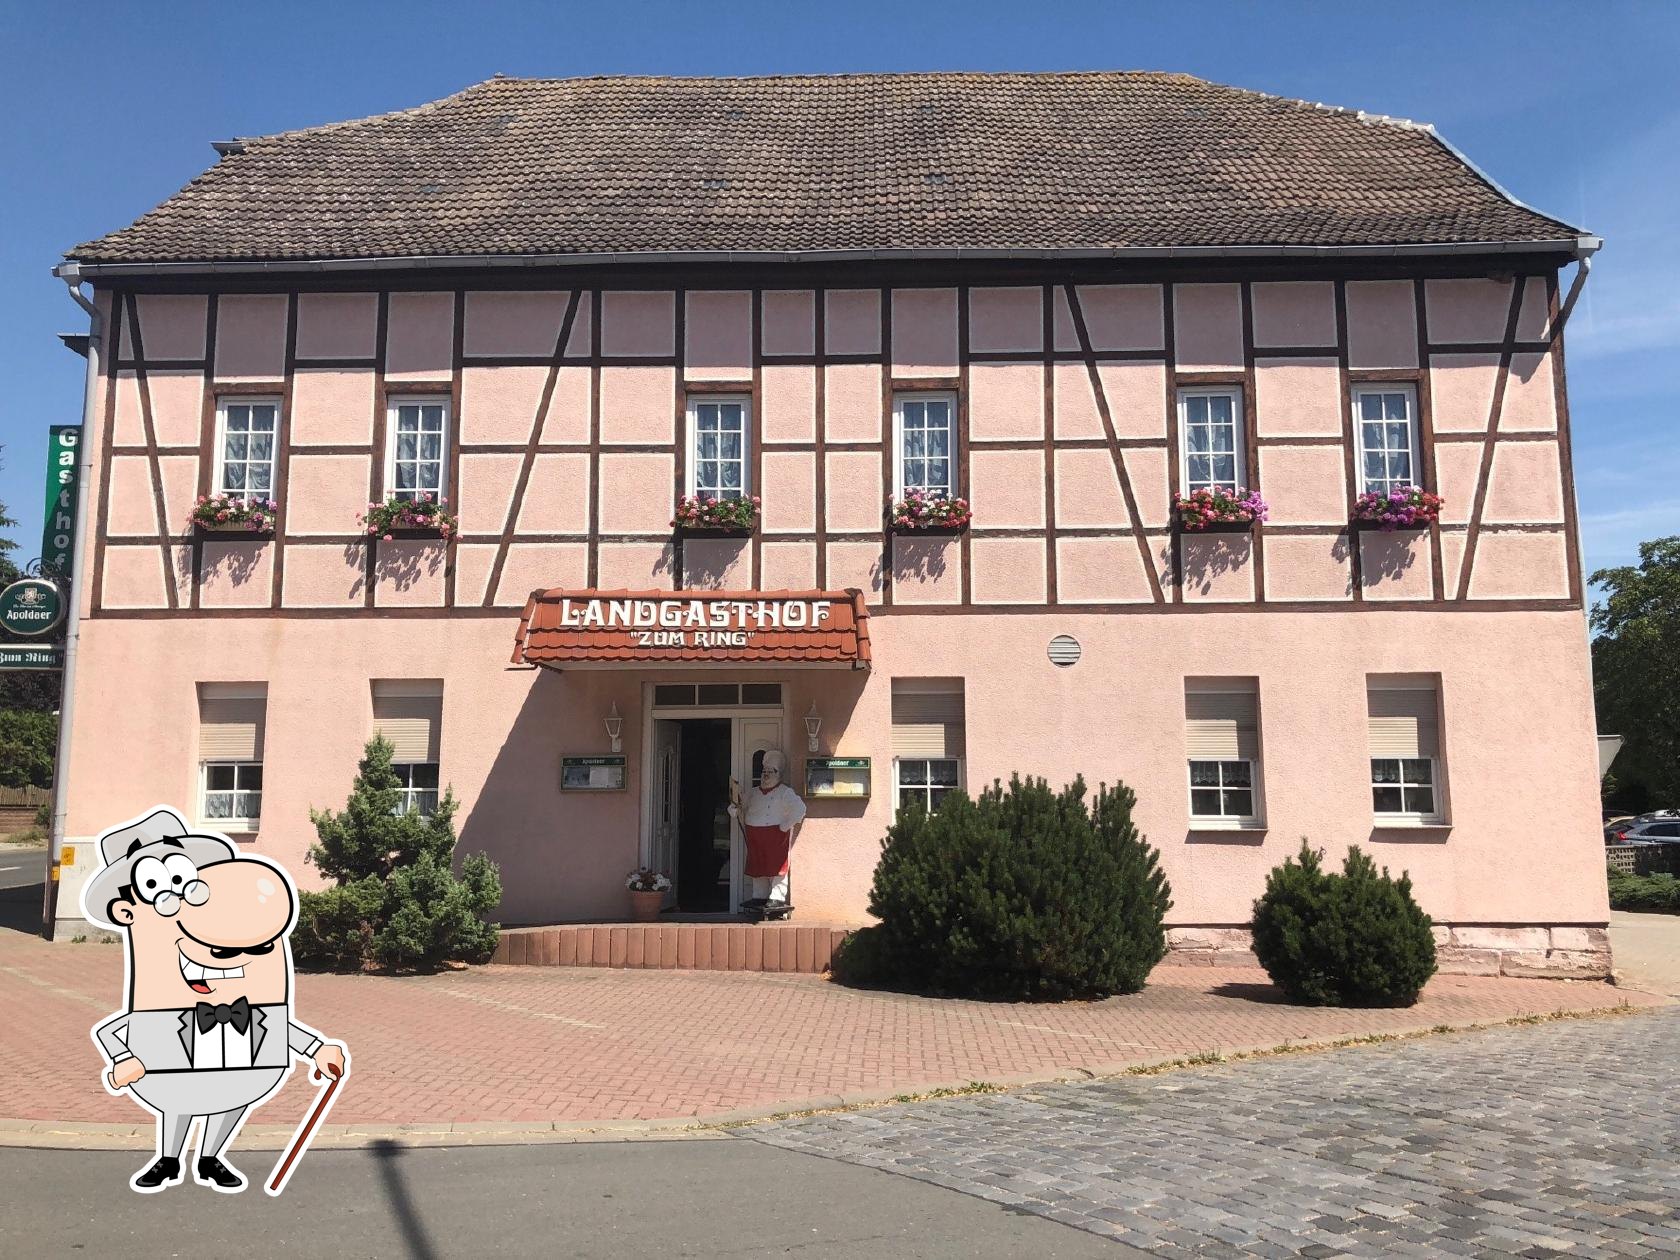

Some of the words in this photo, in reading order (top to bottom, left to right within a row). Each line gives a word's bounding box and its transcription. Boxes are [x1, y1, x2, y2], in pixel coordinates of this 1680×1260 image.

[54, 428, 78, 571] Gasthof
[7, 609, 52, 620] Apoldaer
[560, 599, 831, 627] LANDGASTHOF
[694, 631, 755, 647] RING"
